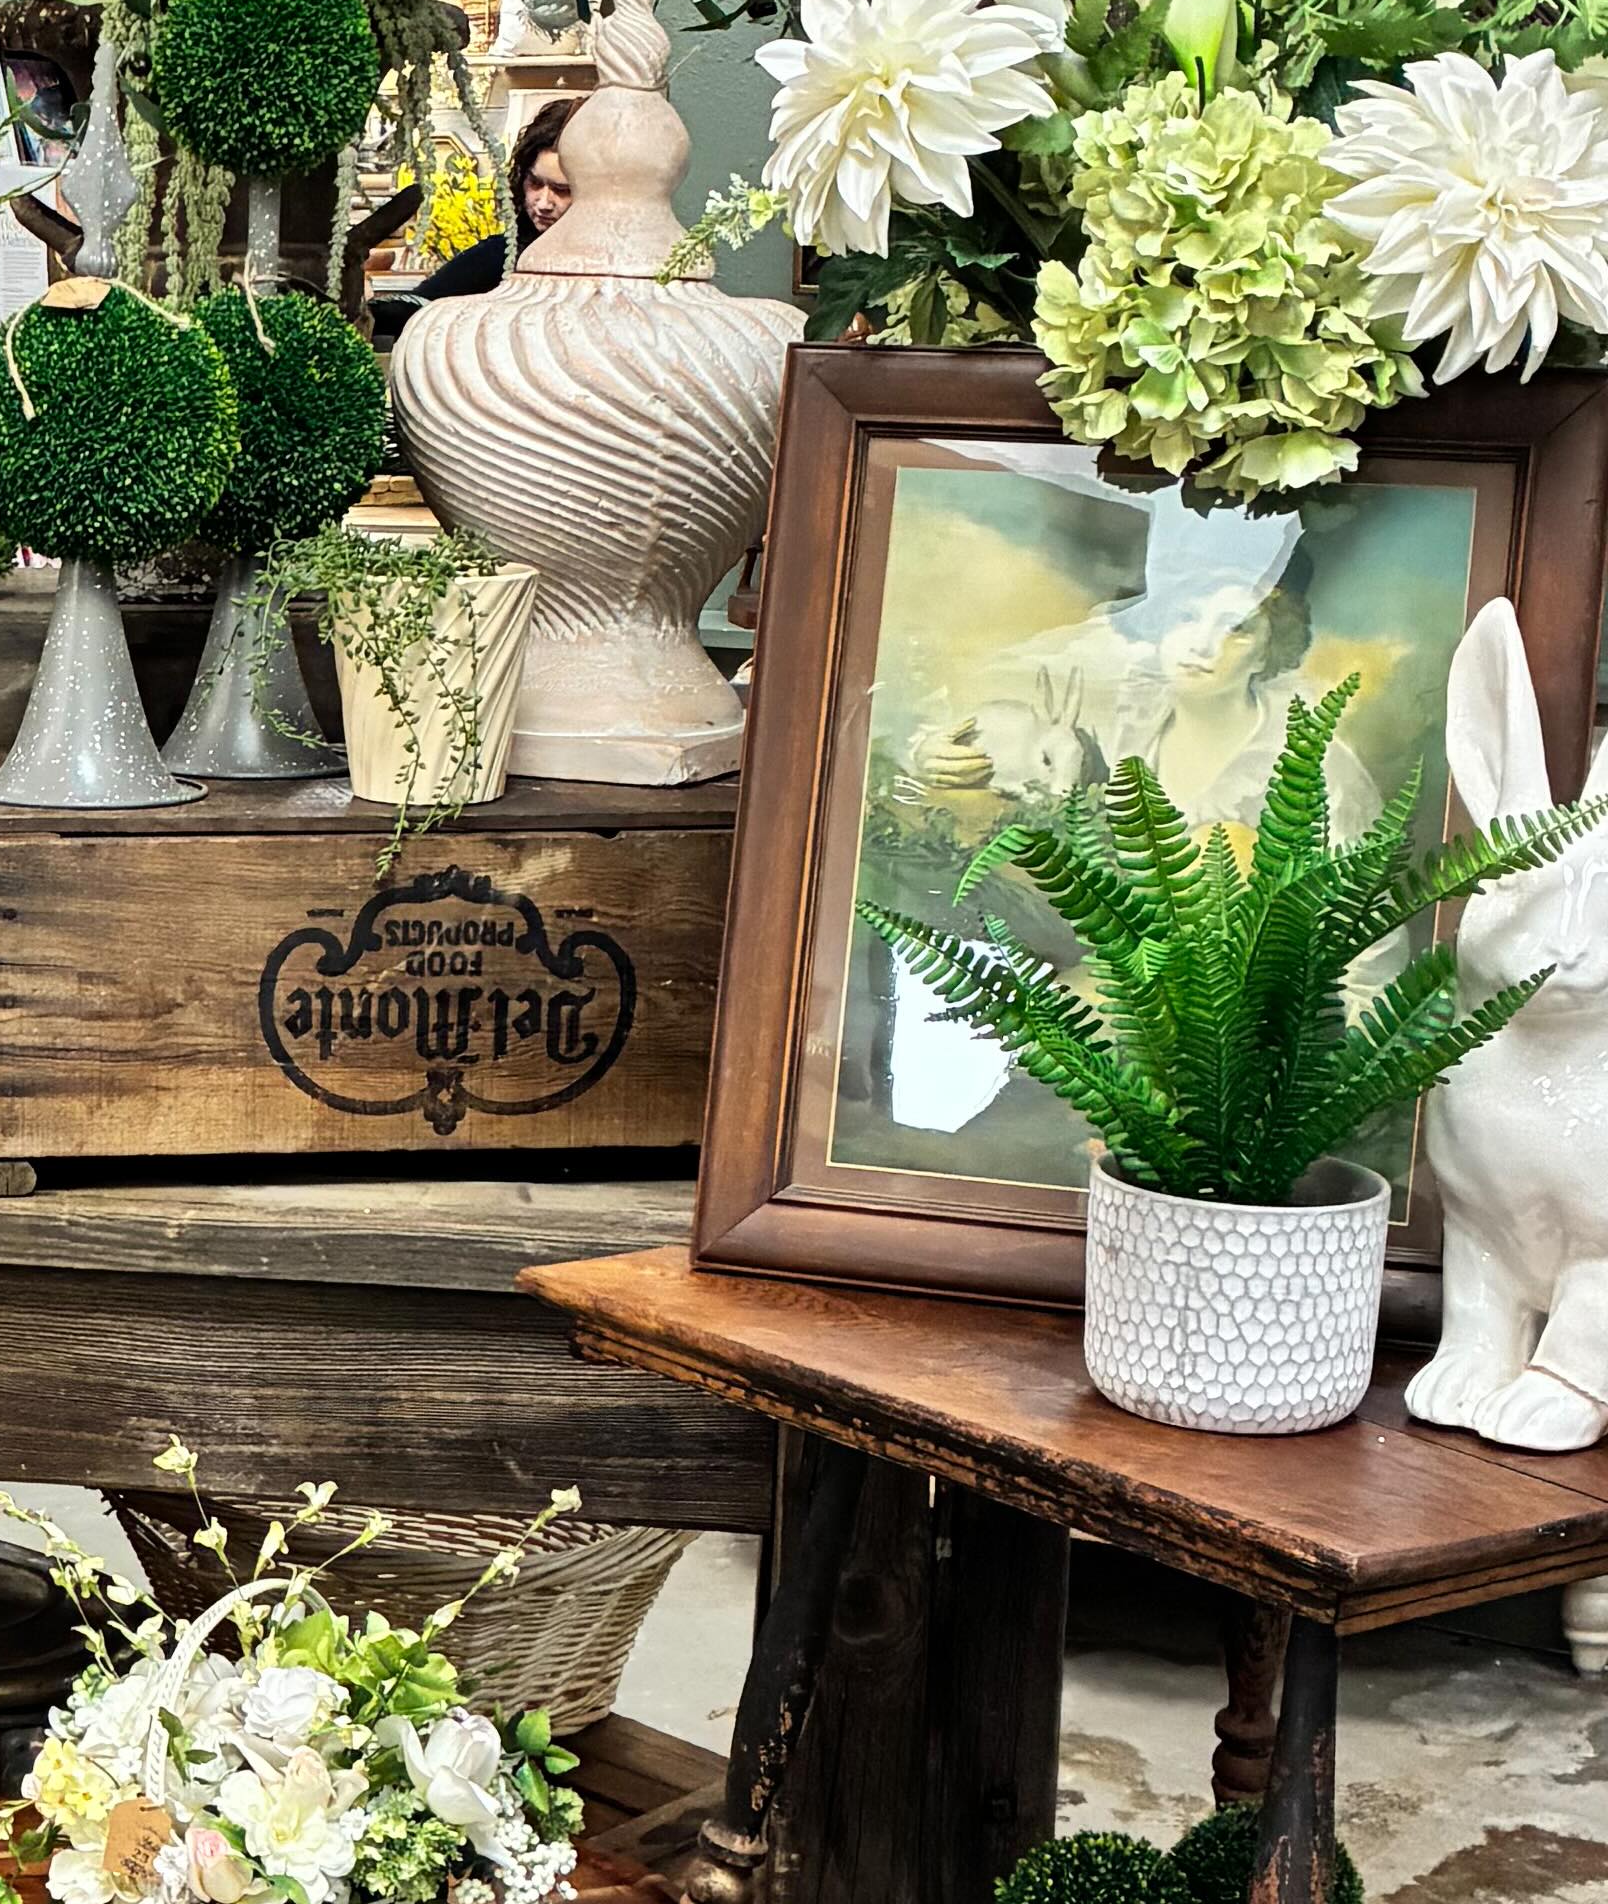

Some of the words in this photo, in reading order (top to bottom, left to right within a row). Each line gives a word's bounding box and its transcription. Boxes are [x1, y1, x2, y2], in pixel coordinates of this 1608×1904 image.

[384, 919, 514, 947] PRODUCTS
[405, 950, 483, 977] FOOD
[285, 985, 481, 1062] Monte
[488, 985, 599, 1065] Del
